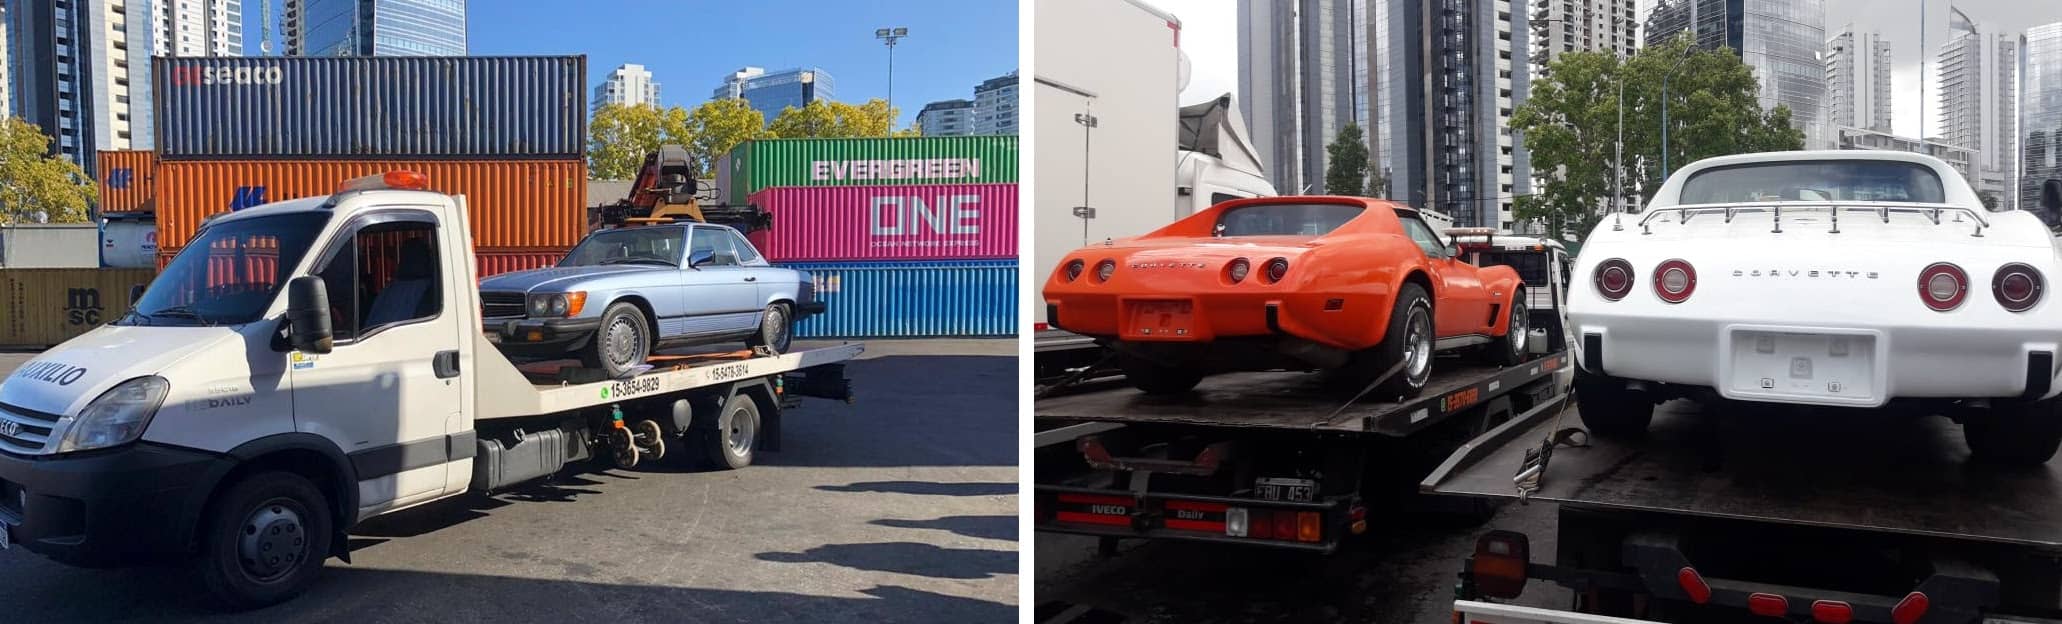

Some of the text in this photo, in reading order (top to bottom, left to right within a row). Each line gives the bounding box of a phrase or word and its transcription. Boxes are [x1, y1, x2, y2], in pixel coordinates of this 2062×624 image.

[812, 158, 980, 181] EVERGREEN
[871, 194, 981, 236] ONE
[1732, 270, 1879, 279] CORVETTE
[611, 376, 660, 399] 15-3654-9829
[1092, 504, 1126, 515] IVECO
[1177, 510, 1204, 521] Daily
